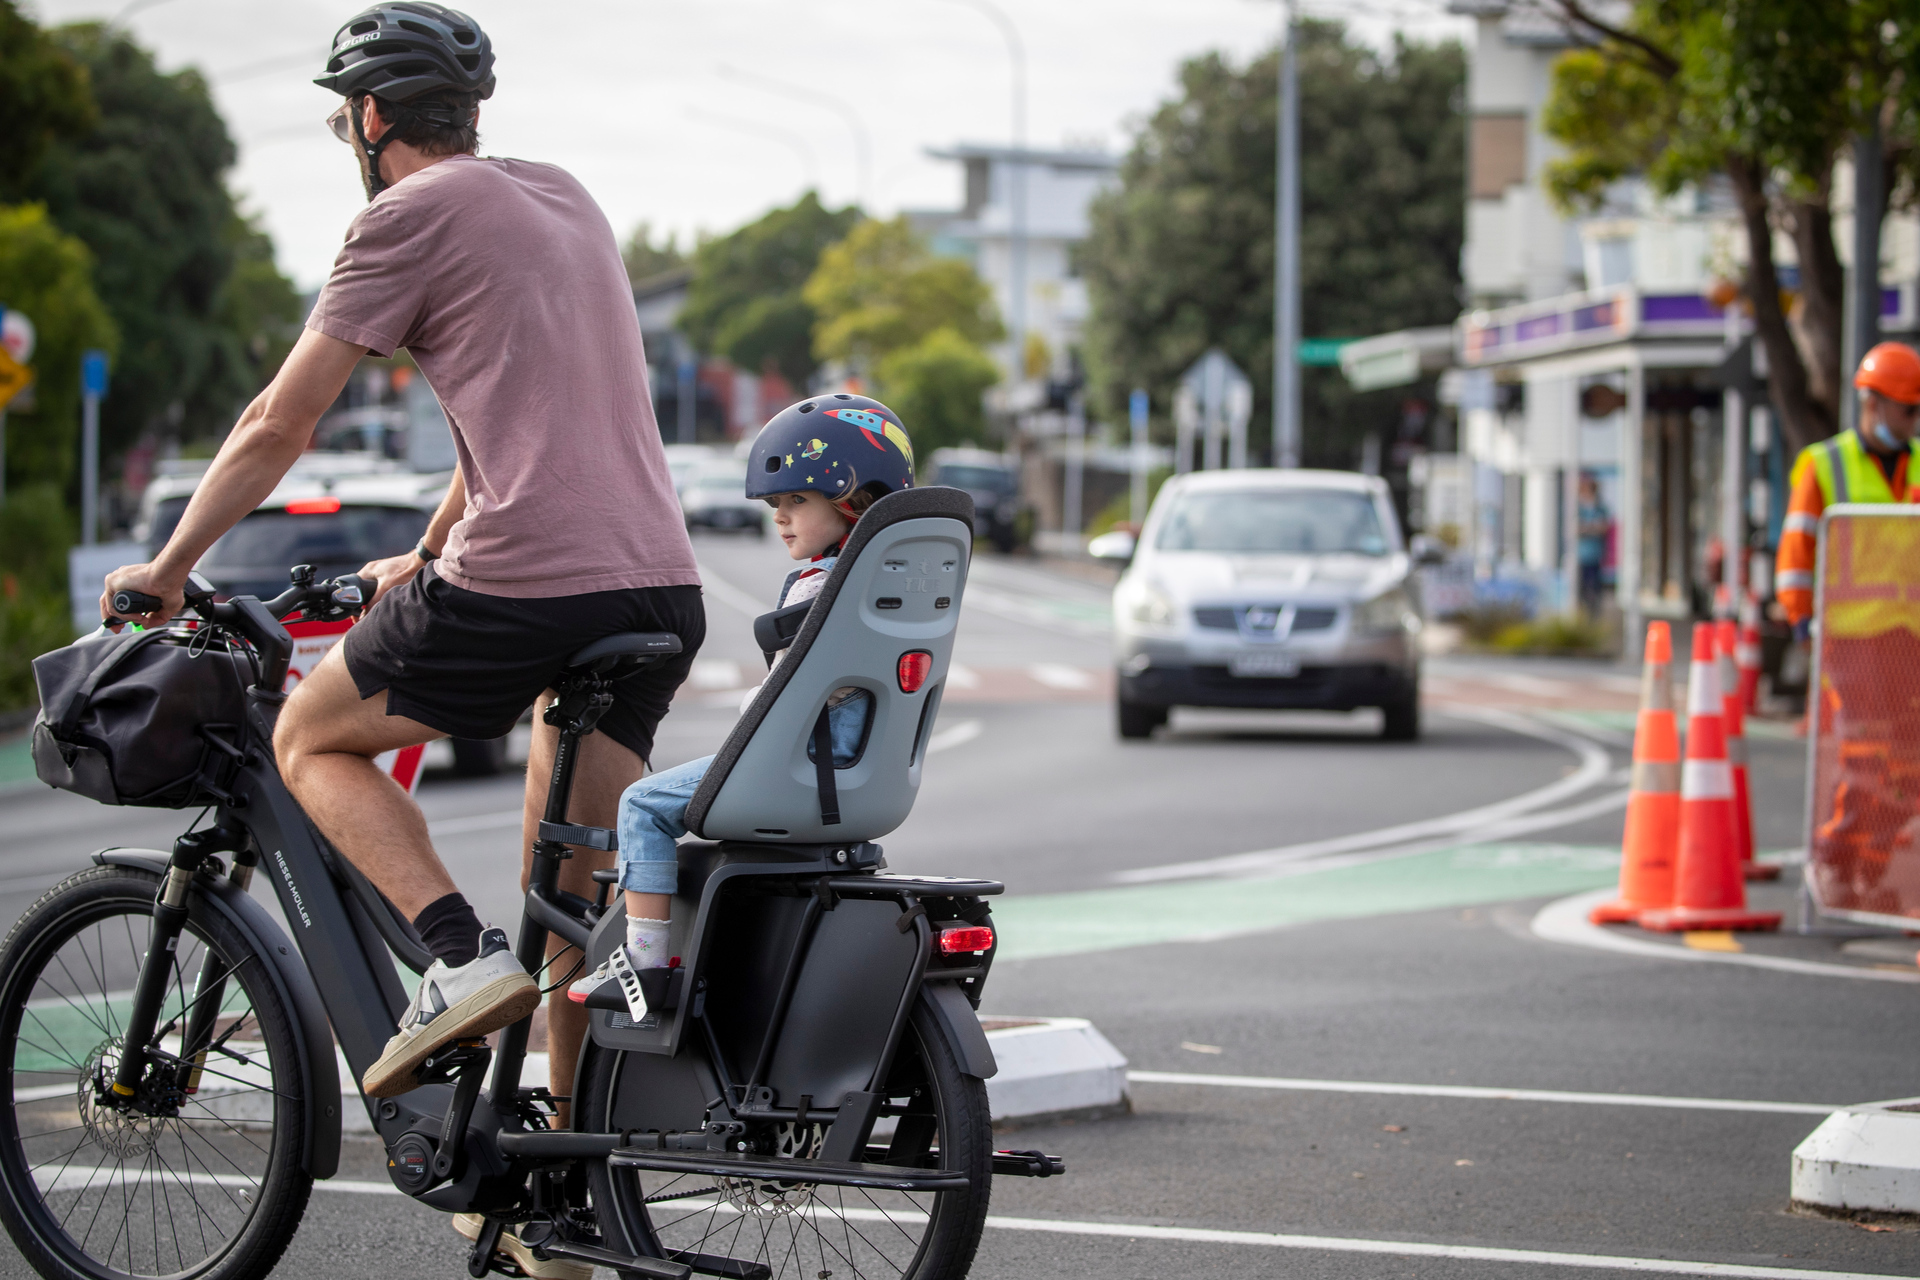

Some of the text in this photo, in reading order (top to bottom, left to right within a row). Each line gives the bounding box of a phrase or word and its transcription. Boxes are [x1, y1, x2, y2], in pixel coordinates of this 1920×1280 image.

[351, 32, 381, 46] GIRO
[274, 849, 293, 882] RIESE
[289, 885, 312, 929] MÜLLER
